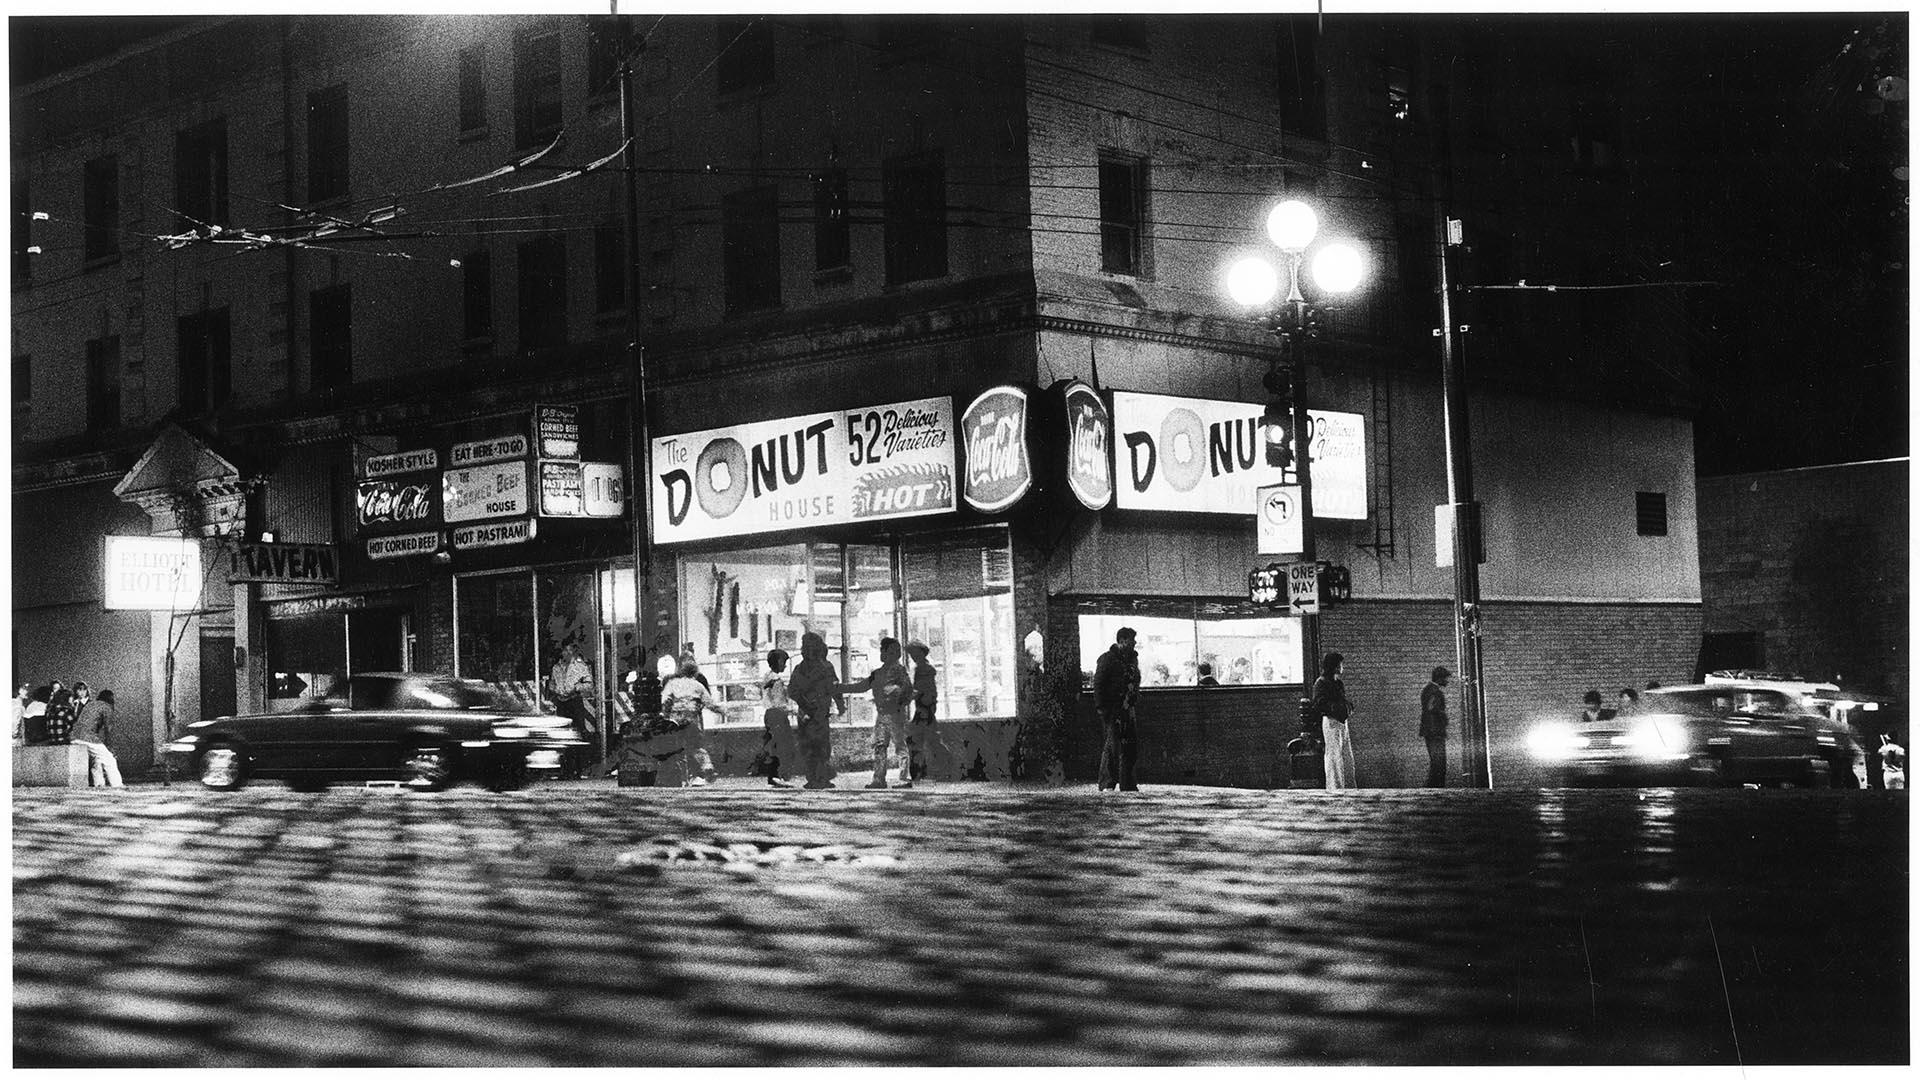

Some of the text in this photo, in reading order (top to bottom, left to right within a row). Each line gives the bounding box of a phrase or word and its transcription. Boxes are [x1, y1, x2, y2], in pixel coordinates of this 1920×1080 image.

[541, 422, 579, 433] CORNED BEEF
[883, 408, 939, 435] Delicious
[847, 411, 882, 467] 52
[883, 429, 947, 458] Varieties
[455, 448, 472, 461] EAT
[510, 440, 524, 453] GO
[661, 438, 688, 466] The
[367, 453, 435, 473] KOSHER STYLE
[660, 418, 835, 527] DONUT
[486, 501, 516, 513] HOUSE
[873, 483, 934, 512] HOT
[769, 495, 835, 522] HOUSE
[368, 535, 436, 555] HOT CORNED BEEF
[455, 524, 529, 545] HOT PASTRAMI
[120, 552, 192, 569] ELLIOTT
[120, 572, 193, 592] HOTEL
[1291, 567, 1316, 580] ONE
[1291, 581, 1316, 593] WAY
